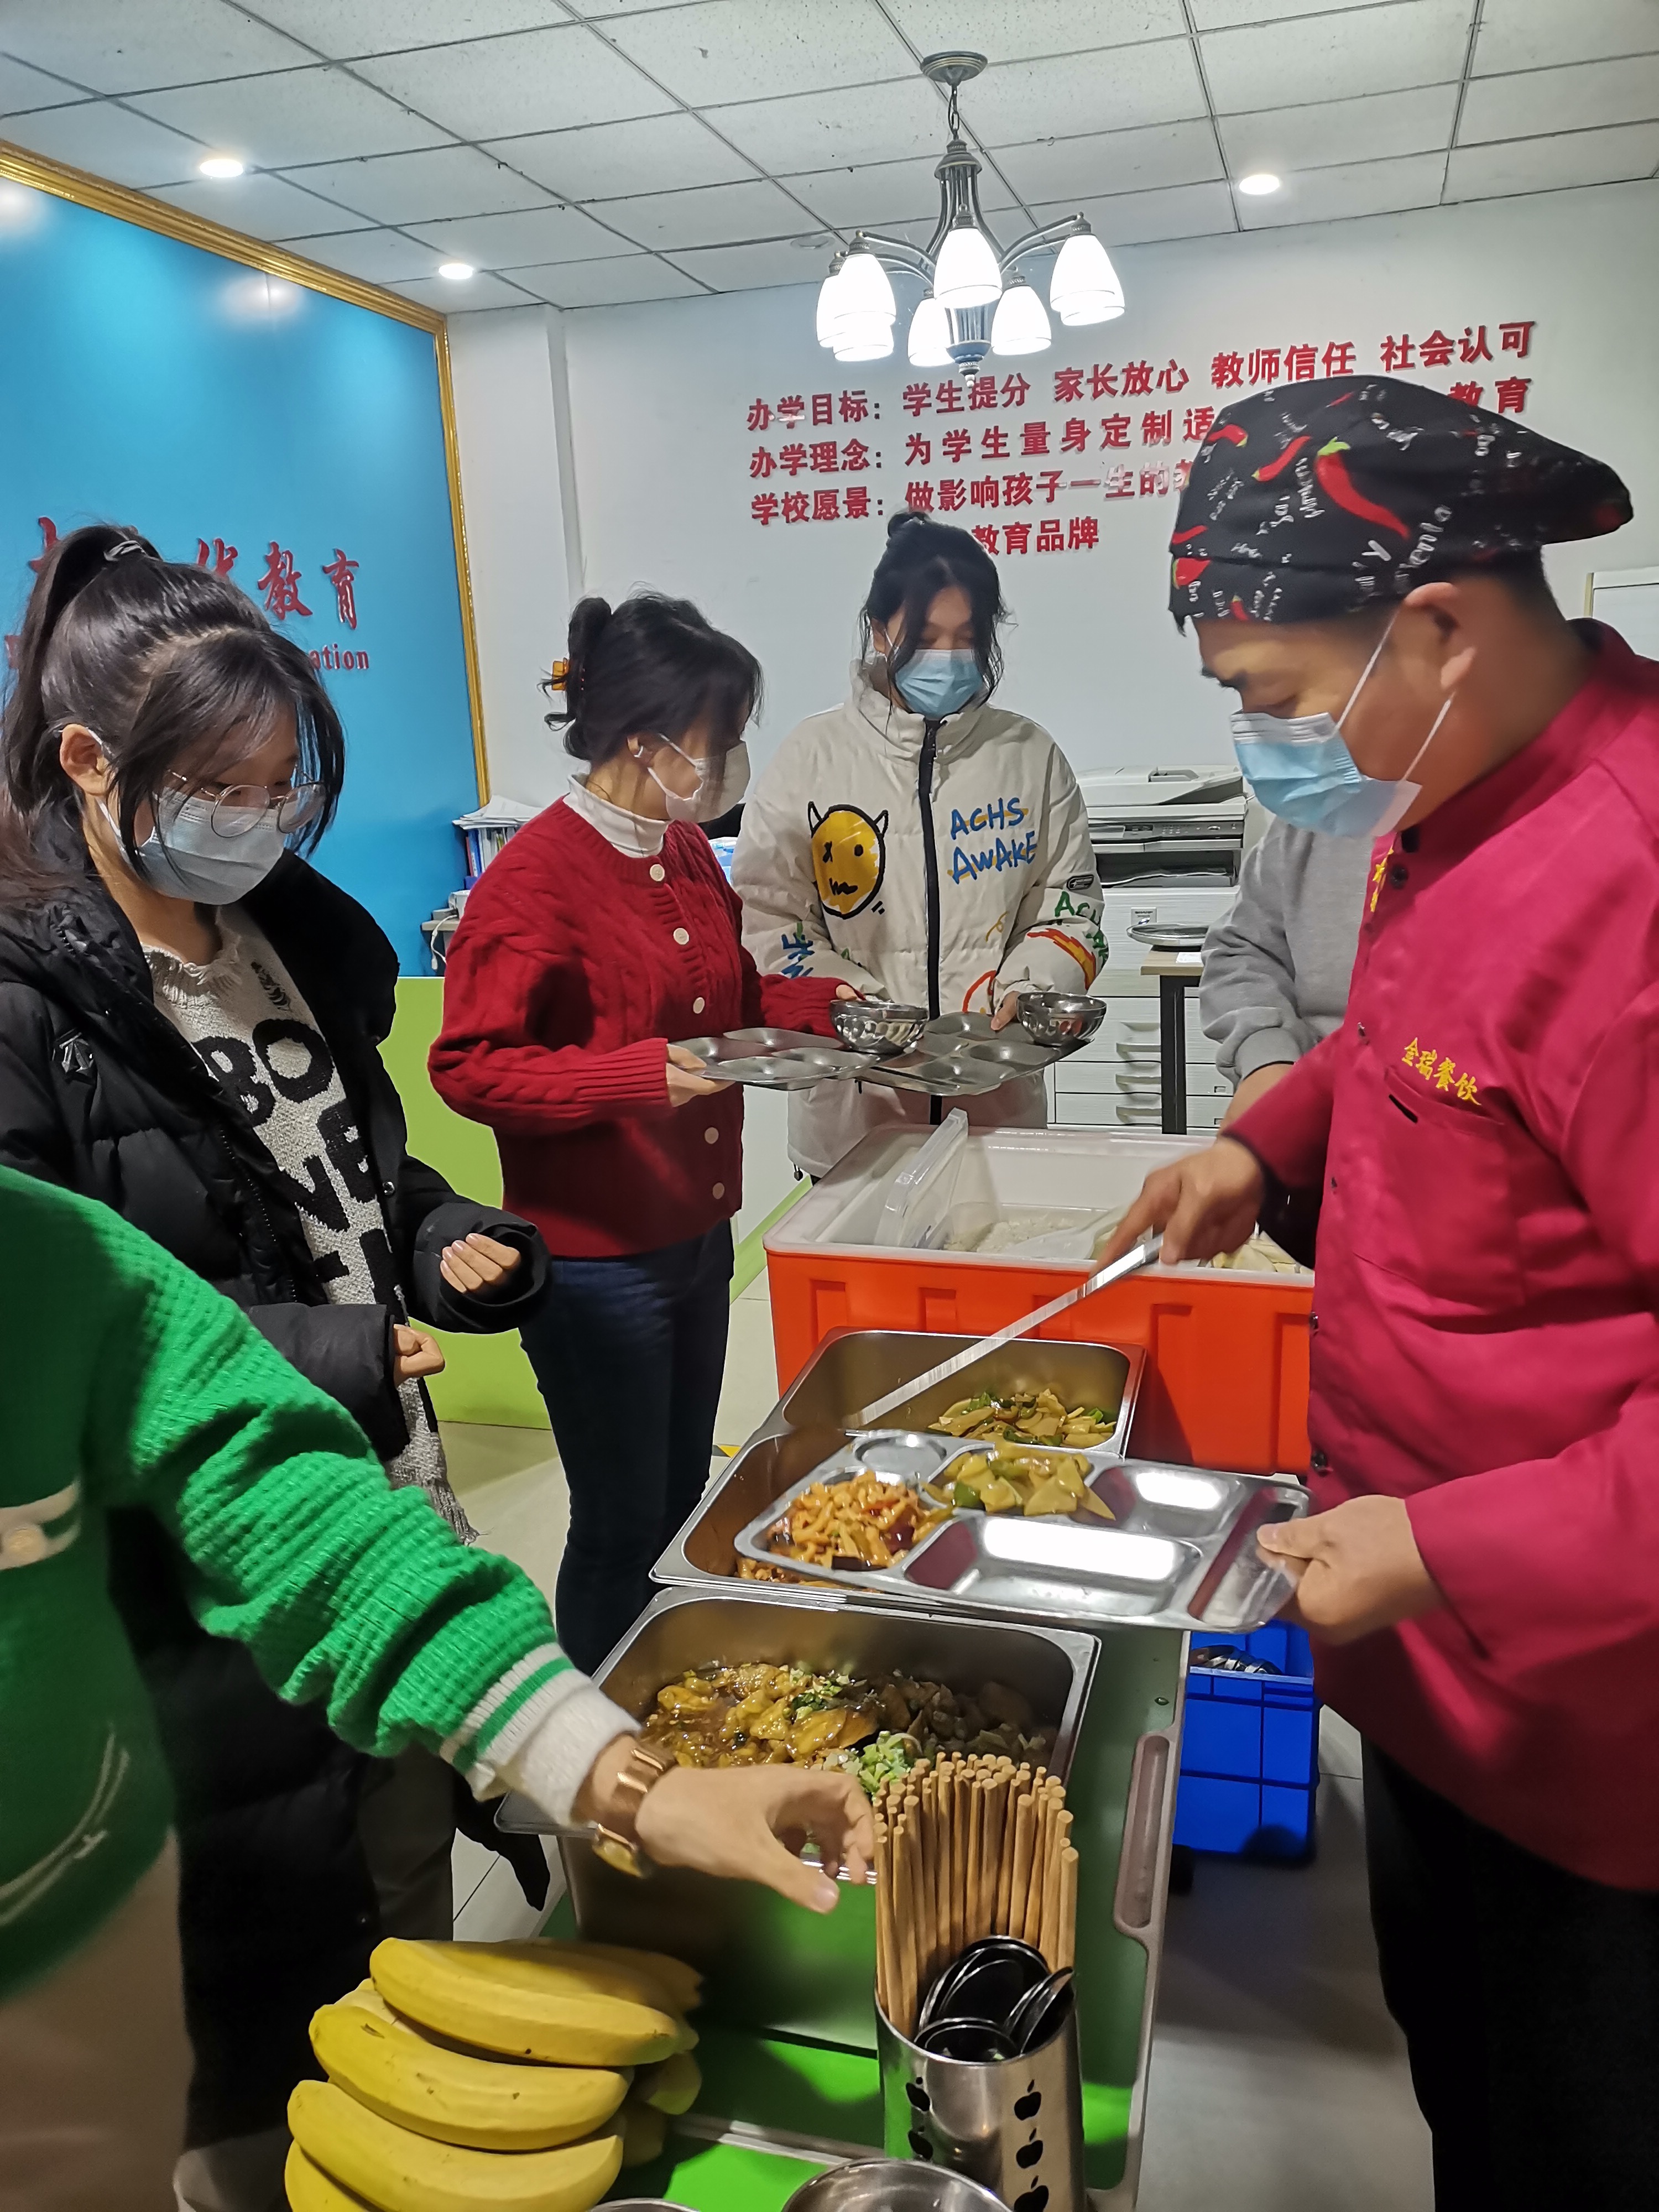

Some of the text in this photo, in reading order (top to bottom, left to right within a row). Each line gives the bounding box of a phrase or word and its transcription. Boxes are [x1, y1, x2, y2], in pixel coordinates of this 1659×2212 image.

[747, 321, 1536, 431] 办学目标： 学生提分 家长放心 教师信任 社会认可
[750, 439, 881, 477] 办学理念：
[905, 406, 1215, 466] 为学生量身定制适
[752, 486, 883, 525] 学校愿景：
[972, 516, 1099, 555] 教育品牌
[951, 797, 1025, 840] ACHS
[952, 831, 1037, 885] AWAKE
